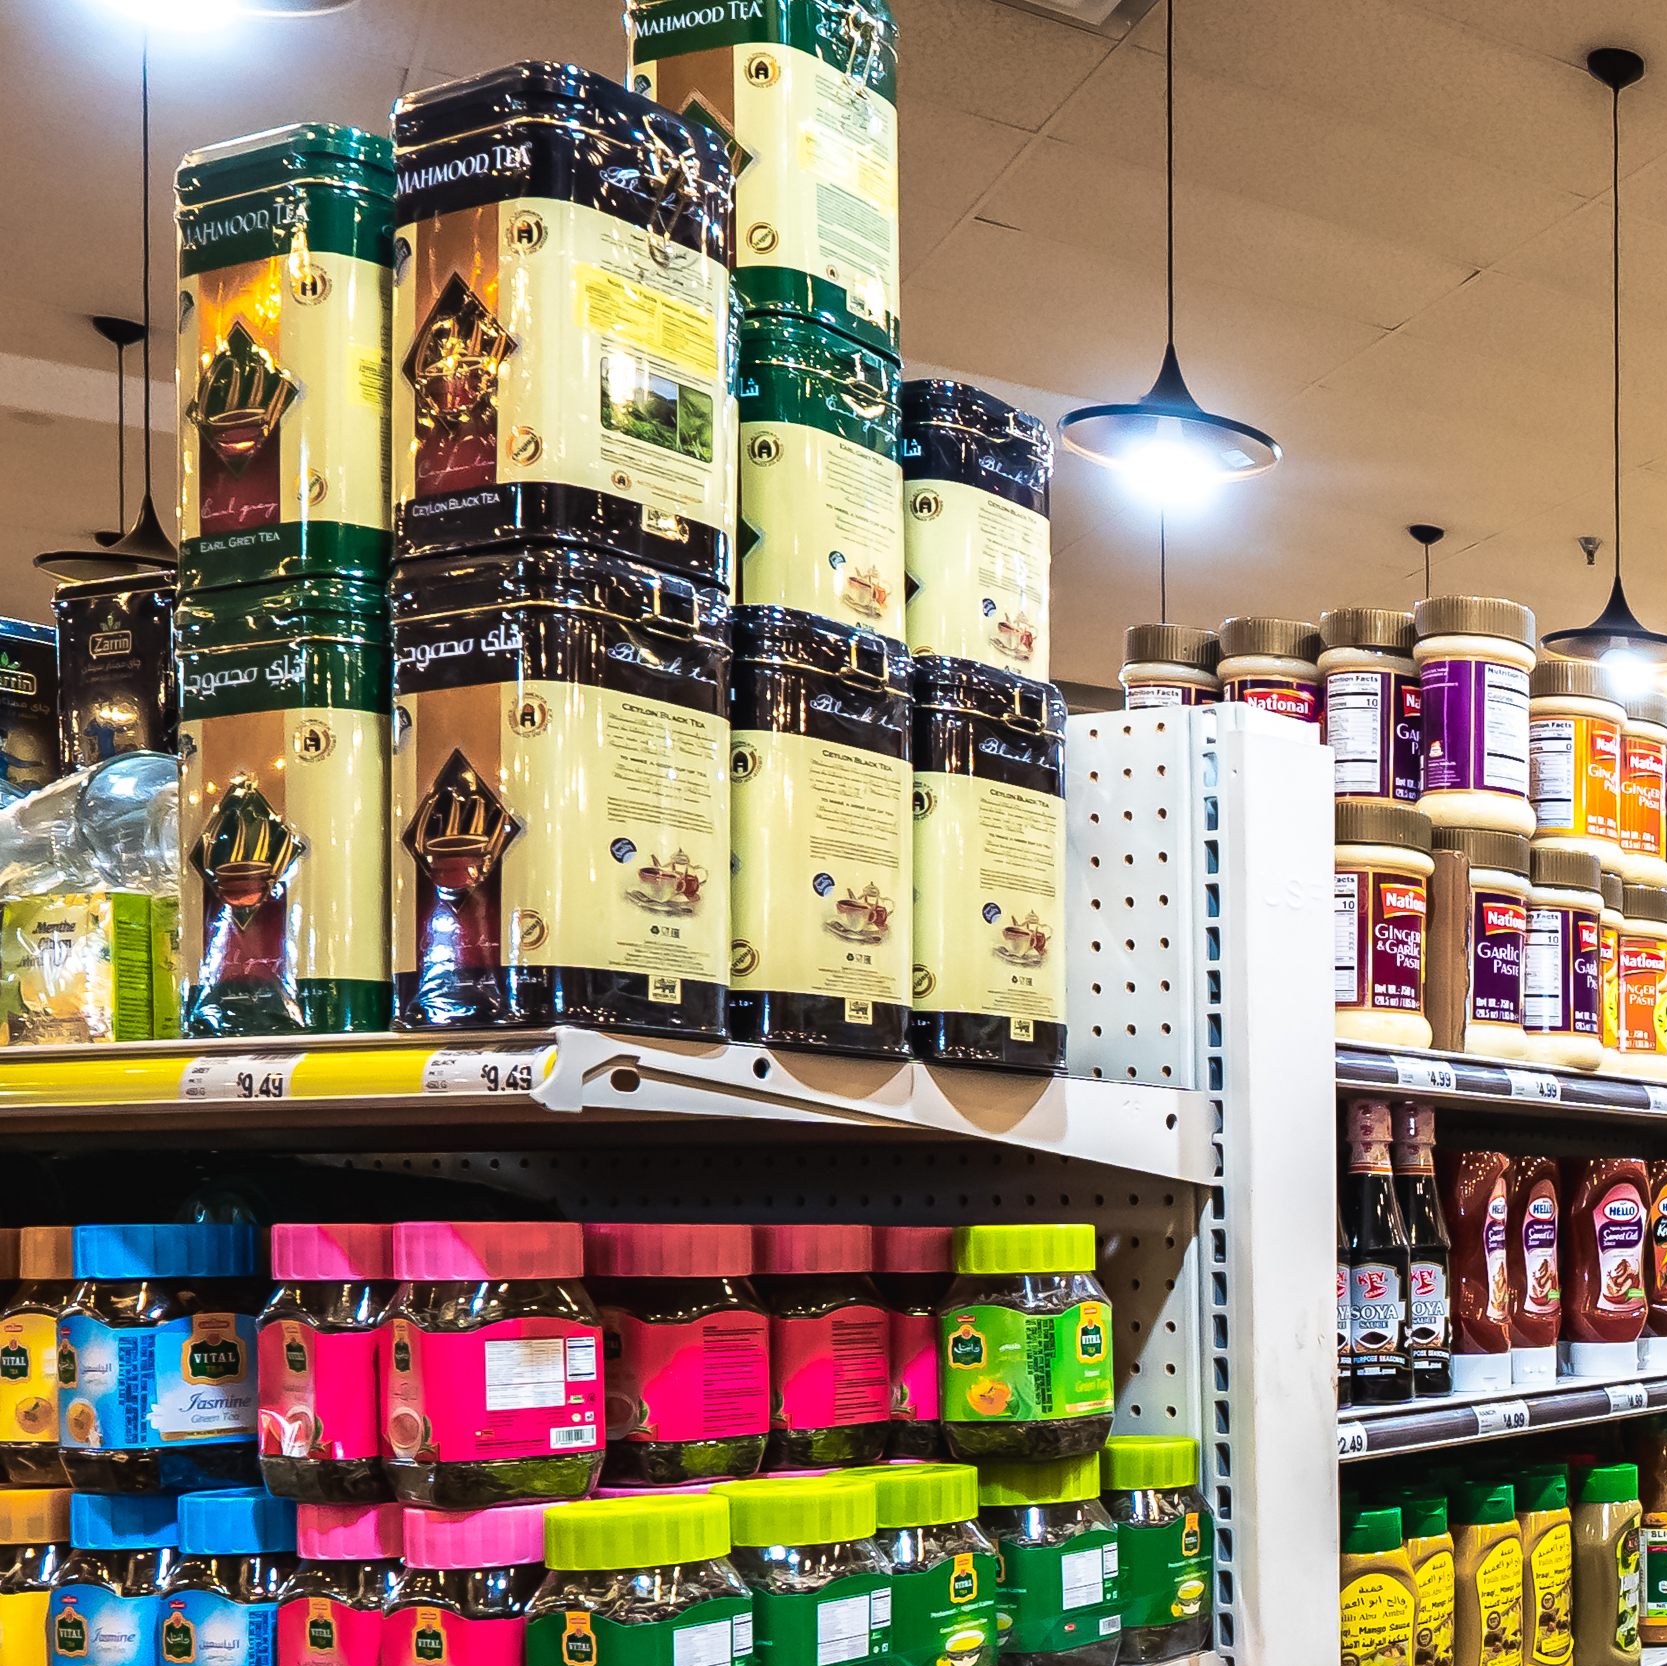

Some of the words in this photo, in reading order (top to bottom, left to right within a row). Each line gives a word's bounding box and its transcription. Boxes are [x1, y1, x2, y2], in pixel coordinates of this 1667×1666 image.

[635, 4, 724, 38] MAHMOOD
[729, 1, 762, 20] TEA
[398, 153, 489, 194] MAHMOOD
[493, 145, 531, 169] TEA
[448, 496, 477, 511] BLACK
[480, 493, 500, 505] TEA
[200, 539, 225, 553] EARL
[228, 535, 256, 550] GREY
[259, 532, 281, 544] TEA
[1355, 675, 1378, 683] Facts
[1248, 694, 1310, 715] National
[1366, 699, 1378, 707] 10
[660, 709, 689, 725] BLACK
[690, 717, 705, 729] TEA
[822, 749, 853, 764] CEYLON
[855, 755, 879, 769] BLACK
[880, 762, 893, 773] TEA
[1016, 792, 1037, 806] BLACK
[1342, 901, 1355, 910] 10
[1493, 959, 1519, 977] PASTE
[1620, 955, 1665, 972] National
[1629, 994, 1655, 1007] PASTE
[236, 1073, 283, 1098] $9.49
[1609, 1206, 1636, 1217] HELLO
[1357, 1272, 1386, 1287] KEY
[1411, 1270, 1434, 1285] KEY
[1351, 1305, 1399, 1321] SOYA
[1412, 1300, 1445, 1317] OYA
[1359, 1321, 1389, 1329] SAUCE
[1412, 1316, 1437, 1325] SAUCE
[1, 1356, 26, 1366] VITAL
[194, 1352, 236, 1364] VITAL
[179, 1393, 251, 1412] Jasmine
[1503, 1412, 1526, 1430] $4.99
[58, 1627, 84, 1641] VITAL
[1359, 1625, 1386, 1634] Mango
[1390, 1622, 1410, 1632] Sauce
[91, 1627, 136, 1646] Jasmine
